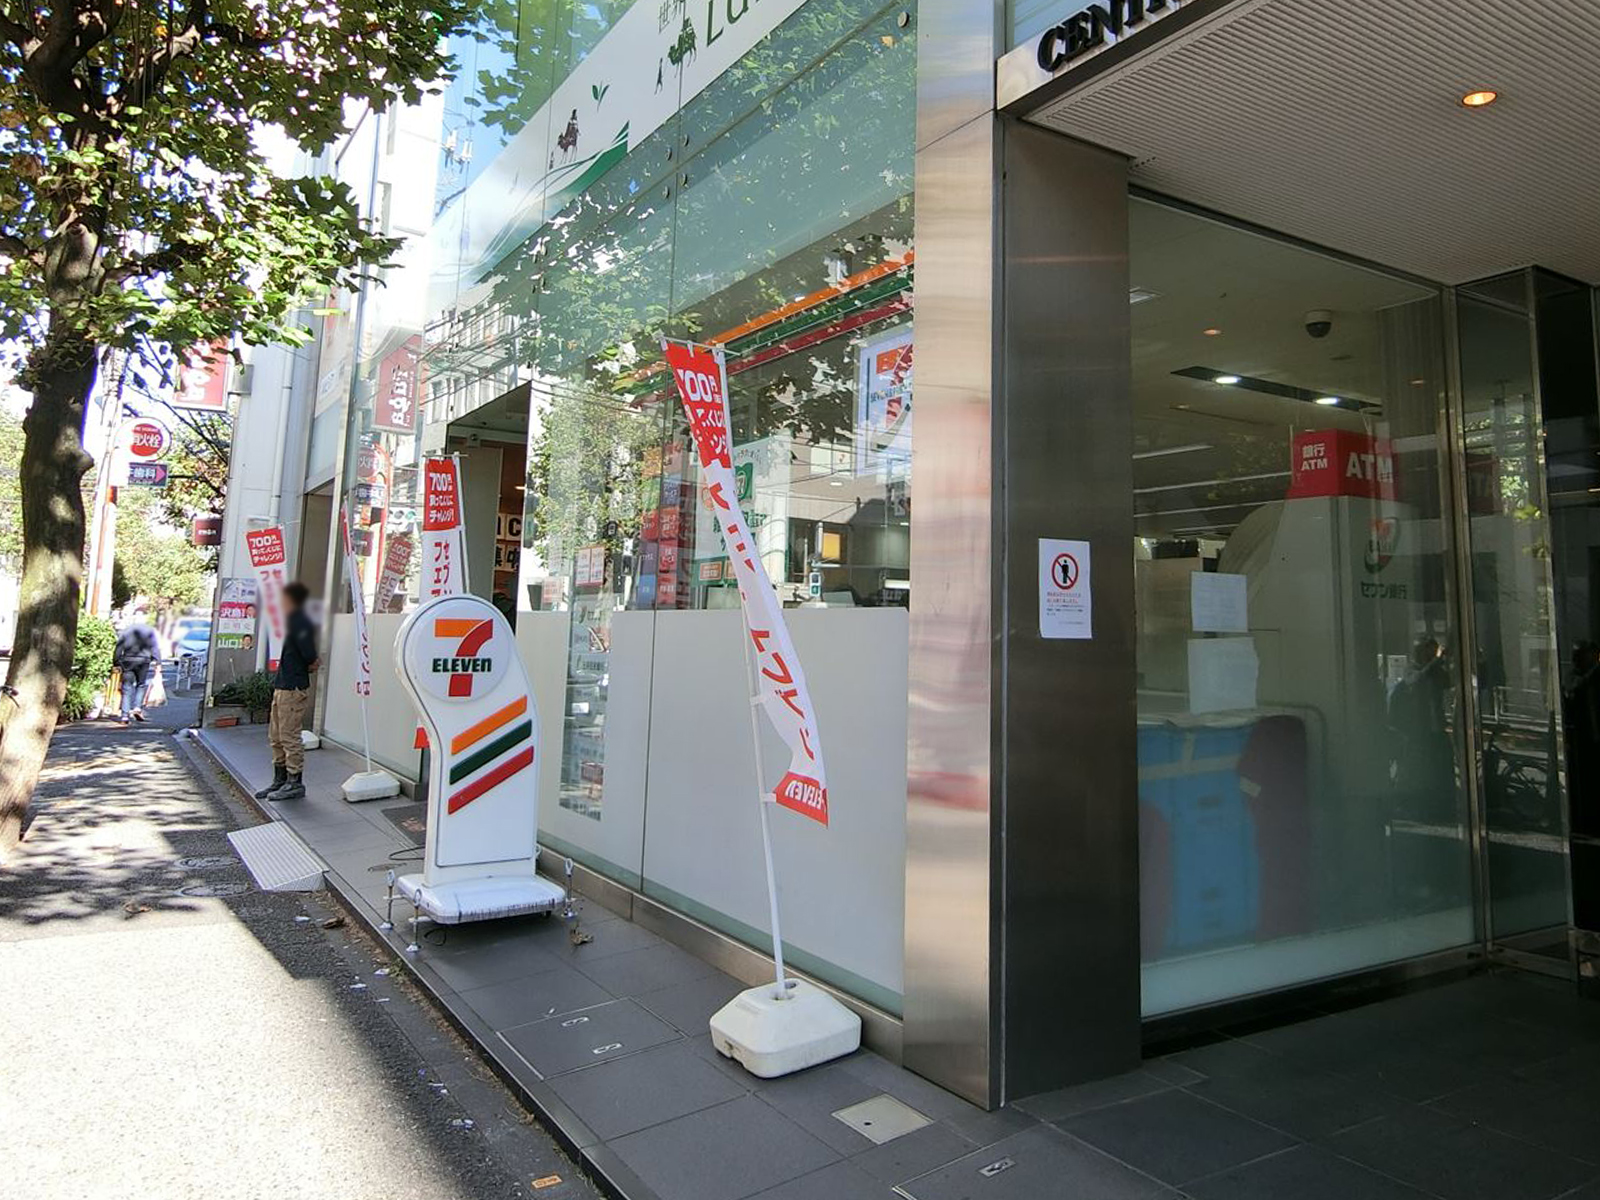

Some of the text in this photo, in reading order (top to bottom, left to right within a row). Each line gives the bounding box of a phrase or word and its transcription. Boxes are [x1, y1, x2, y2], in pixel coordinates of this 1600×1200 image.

[1302, 443, 1325, 459] 銀行
[1301, 458, 1328, 471] ATM
[1346, 452, 1393, 484] ATM
[1360, 581, 1407, 599] セブン銀行
[434, 618, 493, 697] 7
